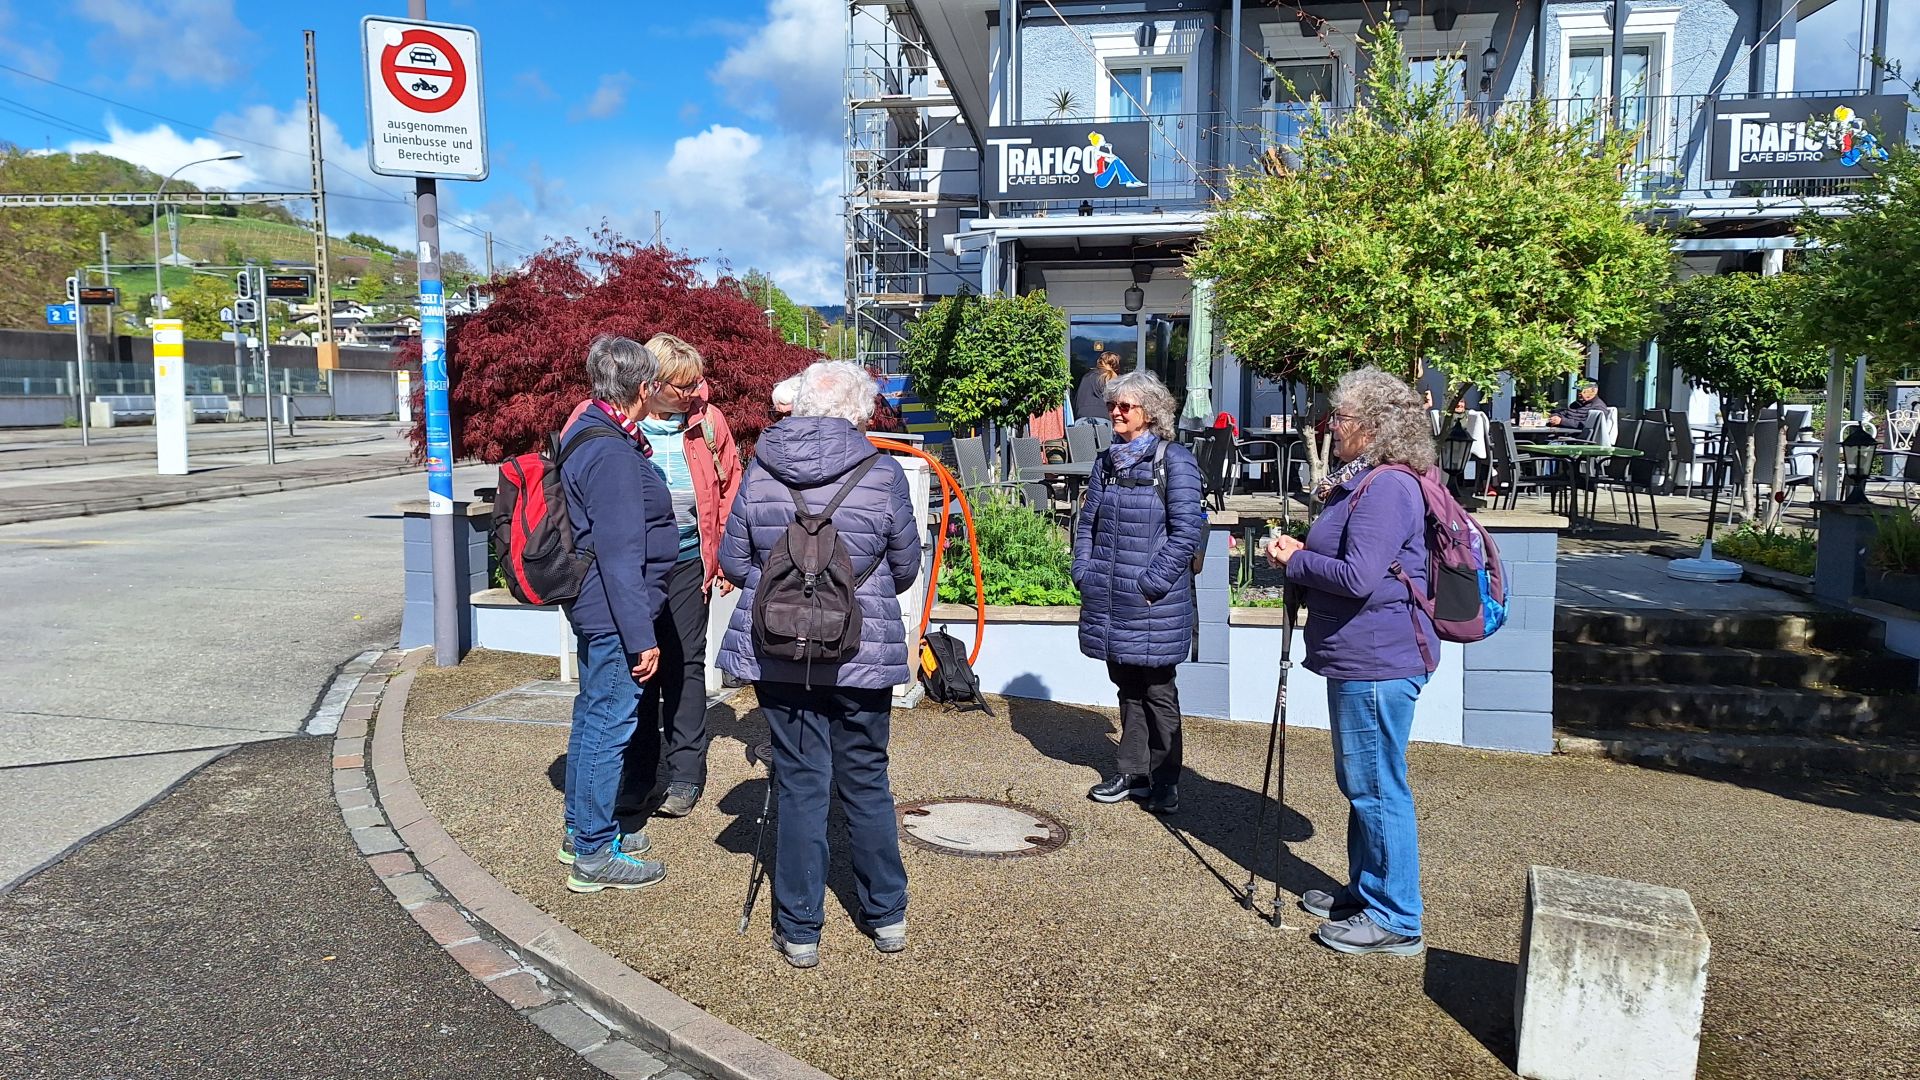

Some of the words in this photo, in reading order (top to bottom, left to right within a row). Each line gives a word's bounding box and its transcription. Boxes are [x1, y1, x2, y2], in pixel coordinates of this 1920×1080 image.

[387, 120, 467, 135] ausgenommen
[383, 133, 447, 148] Linienbusse
[452, 139, 473, 150] und
[398, 149, 460, 165] Berechtigte
[1741, 152, 1773, 163] CAFE
[1776, 151, 1824, 163] BISTRO
[987, 138, 1097, 193] TRAFICO
[1008, 175, 1037, 186] CAFE
[1039, 174, 1080, 185] BISTRO
[52, 310, 61, 321] 2
